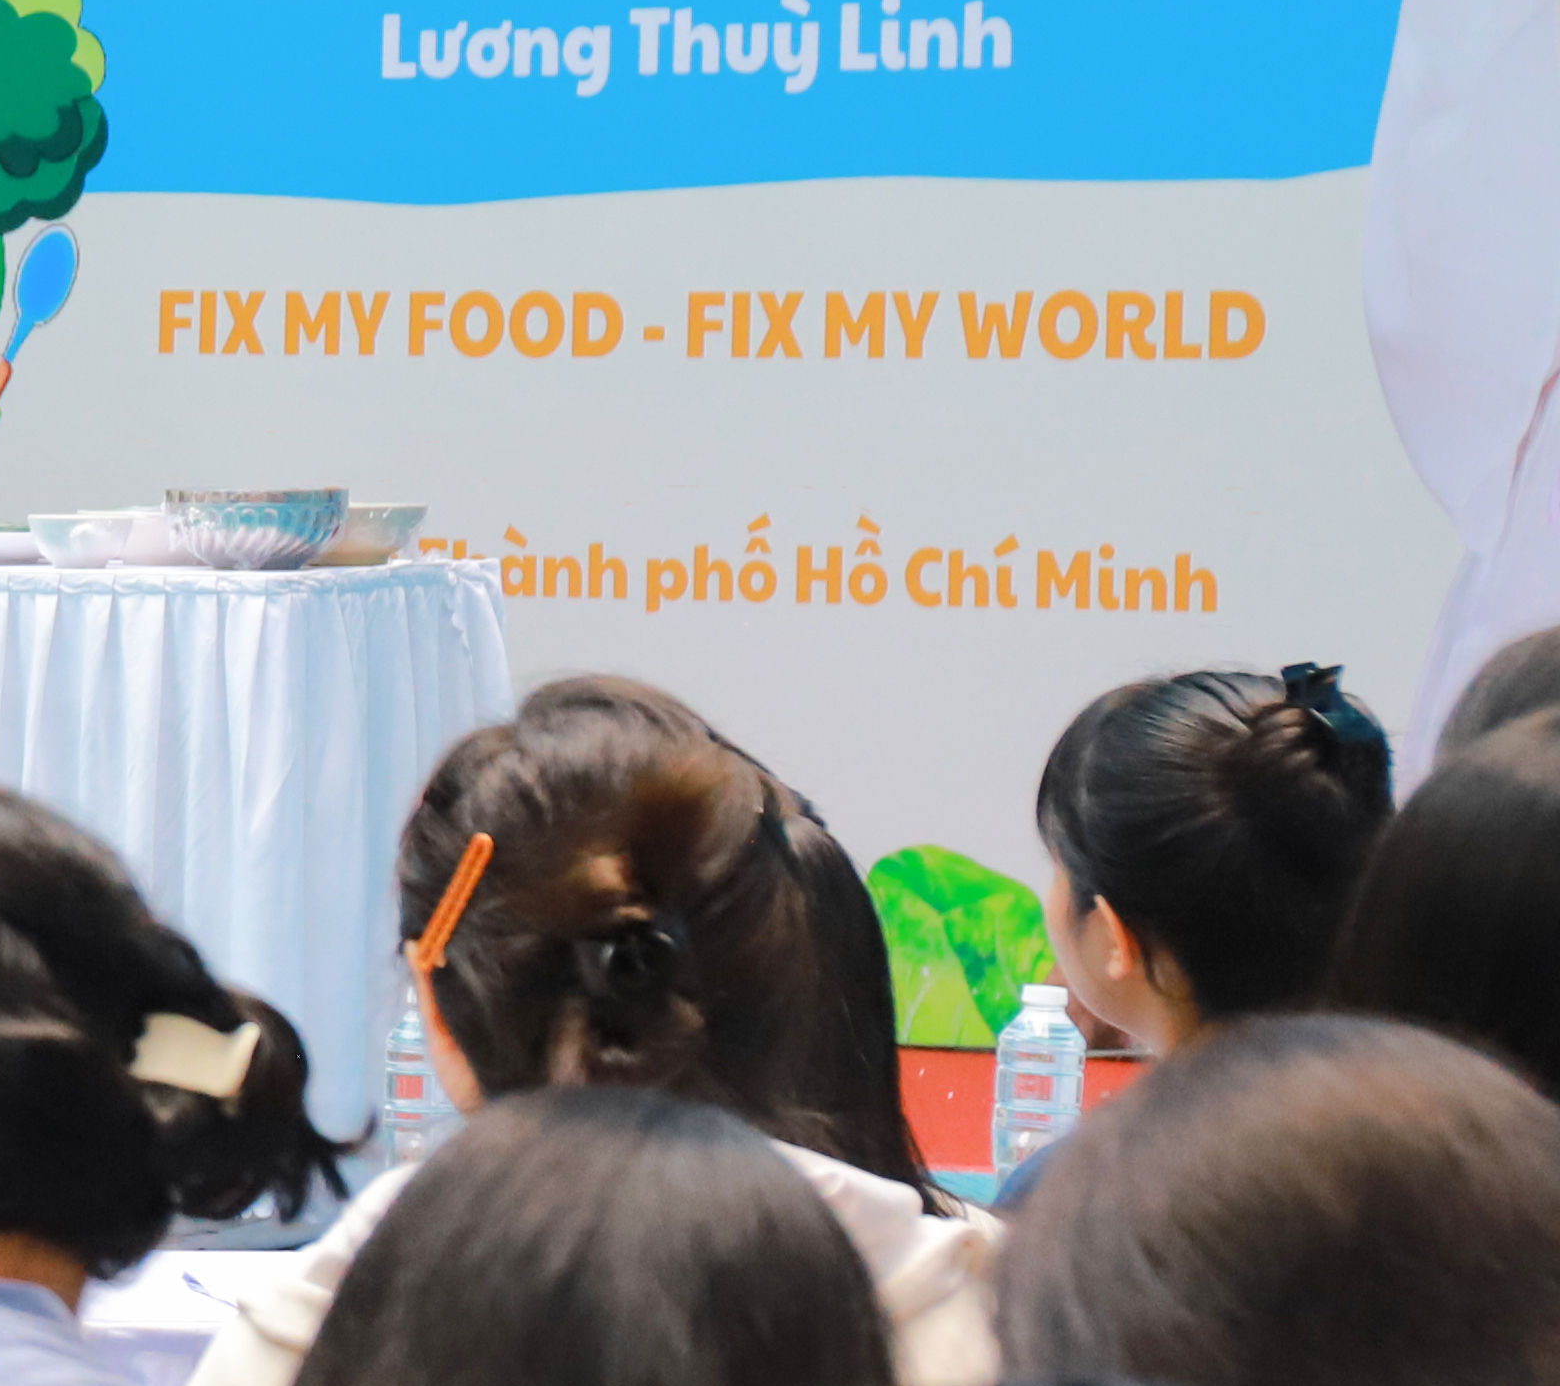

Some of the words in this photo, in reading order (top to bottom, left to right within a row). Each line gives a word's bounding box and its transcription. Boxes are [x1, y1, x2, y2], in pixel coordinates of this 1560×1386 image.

[382, 14, 610, 96] Lương
[159, 291, 265, 354] FIX
[285, 292, 389, 355] MY
[409, 291, 623, 358] FOOD
[688, 292, 803, 358] FIX
[825, 292, 939, 358] MY
[959, 290, 1265, 360] WORLD
[647, 515, 776, 612] phố
[797, 516, 887, 605] Hồ
[905, 536, 1018, 608] Chí
[1037, 544, 1217, 612] Minh
